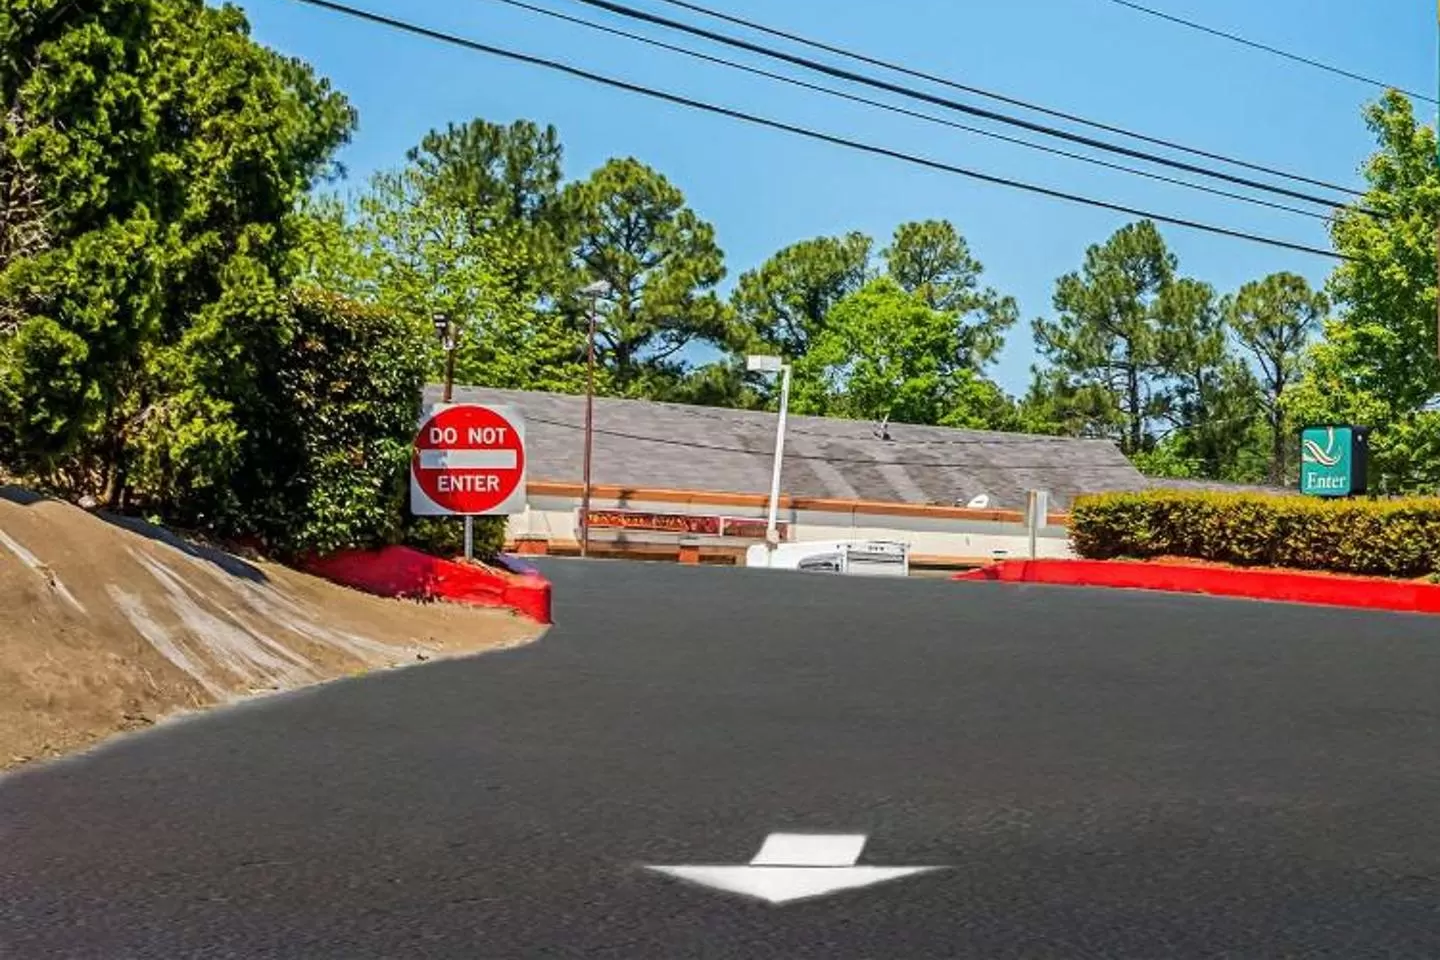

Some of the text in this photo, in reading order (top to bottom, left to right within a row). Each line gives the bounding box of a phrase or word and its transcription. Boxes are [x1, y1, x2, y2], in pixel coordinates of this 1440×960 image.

[429, 427, 507, 445] DO NOT
[437, 475, 500, 492] ENTER
[1306, 471, 1346, 489] Enter
